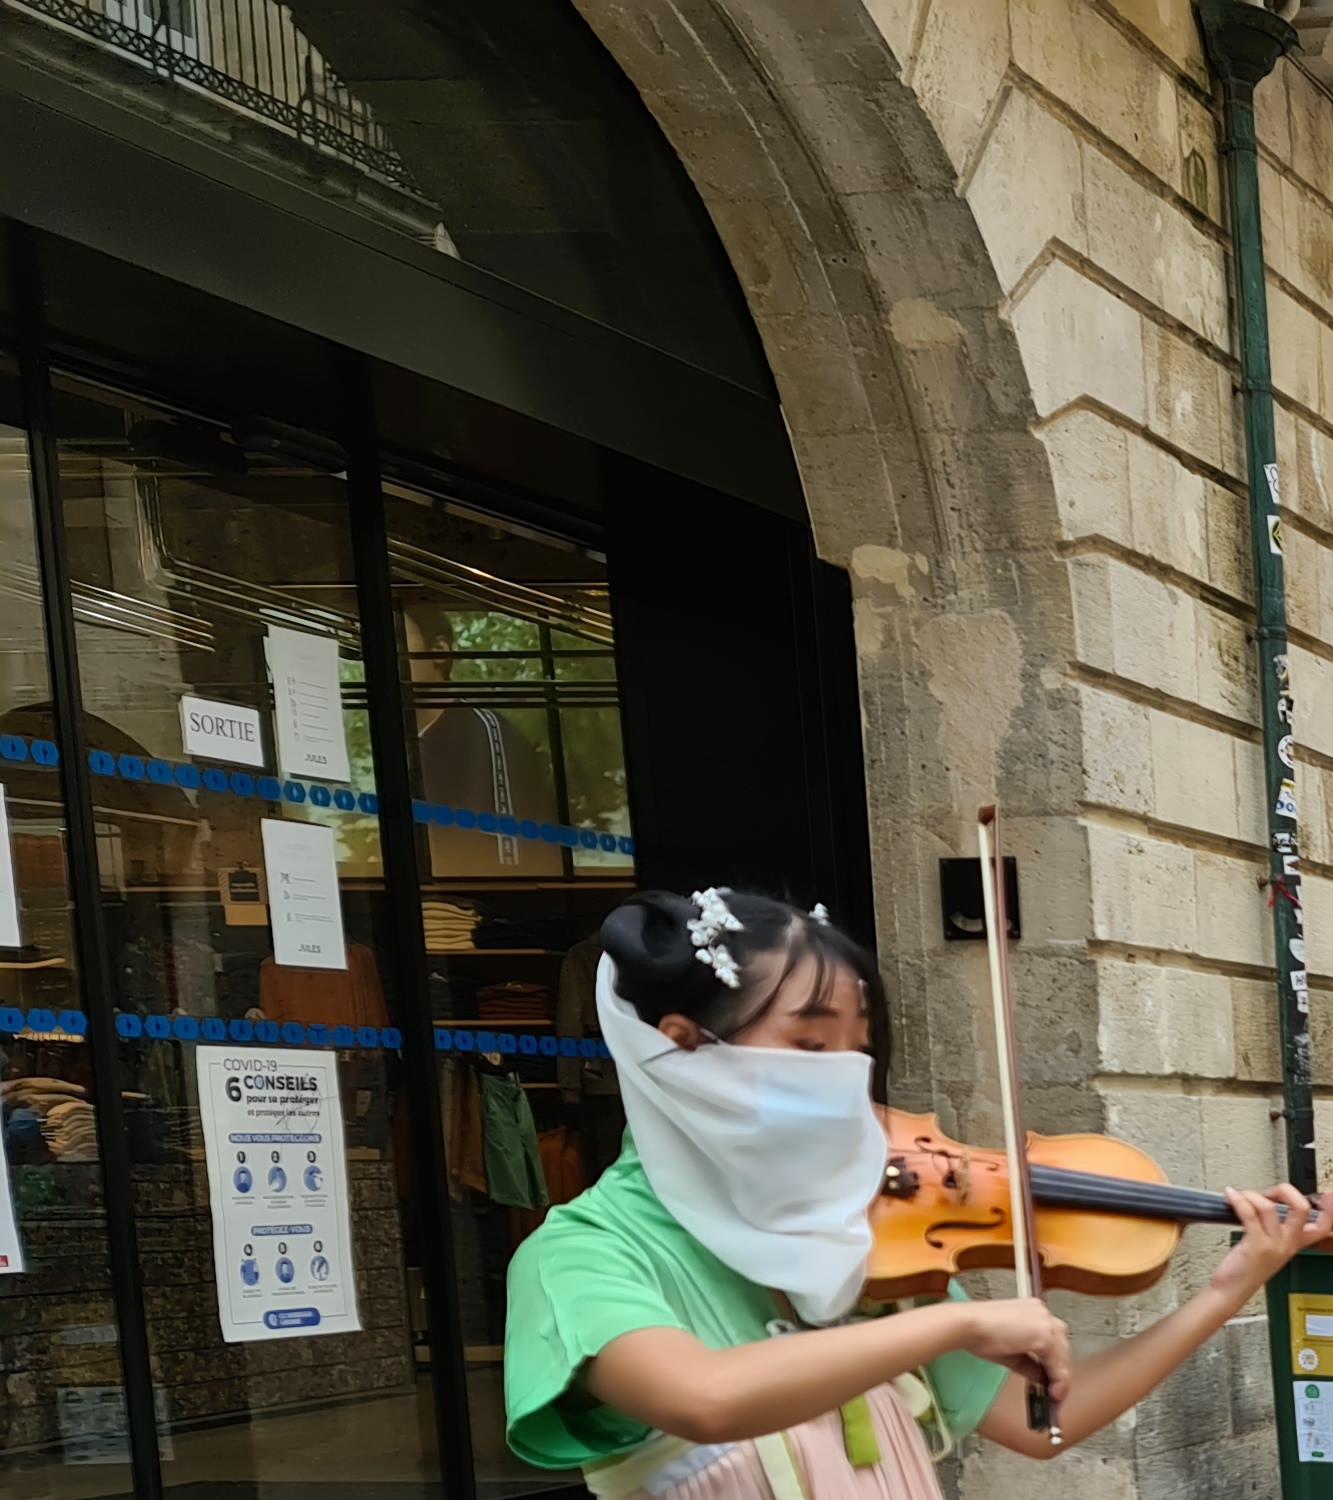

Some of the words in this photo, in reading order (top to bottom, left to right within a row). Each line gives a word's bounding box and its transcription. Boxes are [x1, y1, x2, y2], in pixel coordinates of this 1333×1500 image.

[189, 711, 256, 743] SORTIE
[304, 753, 328, 765] JULES
[298, 943, 322, 954] JULES
[223, 1058, 278, 1072] COVID-19
[225, 1076, 242, 1102] 6
[243, 1074, 318, 1092] CONSEILS
[246, 1094, 266, 1105] pour
[268, 1095, 278, 1103] se
[280, 1093, 319, 1106] protéger
